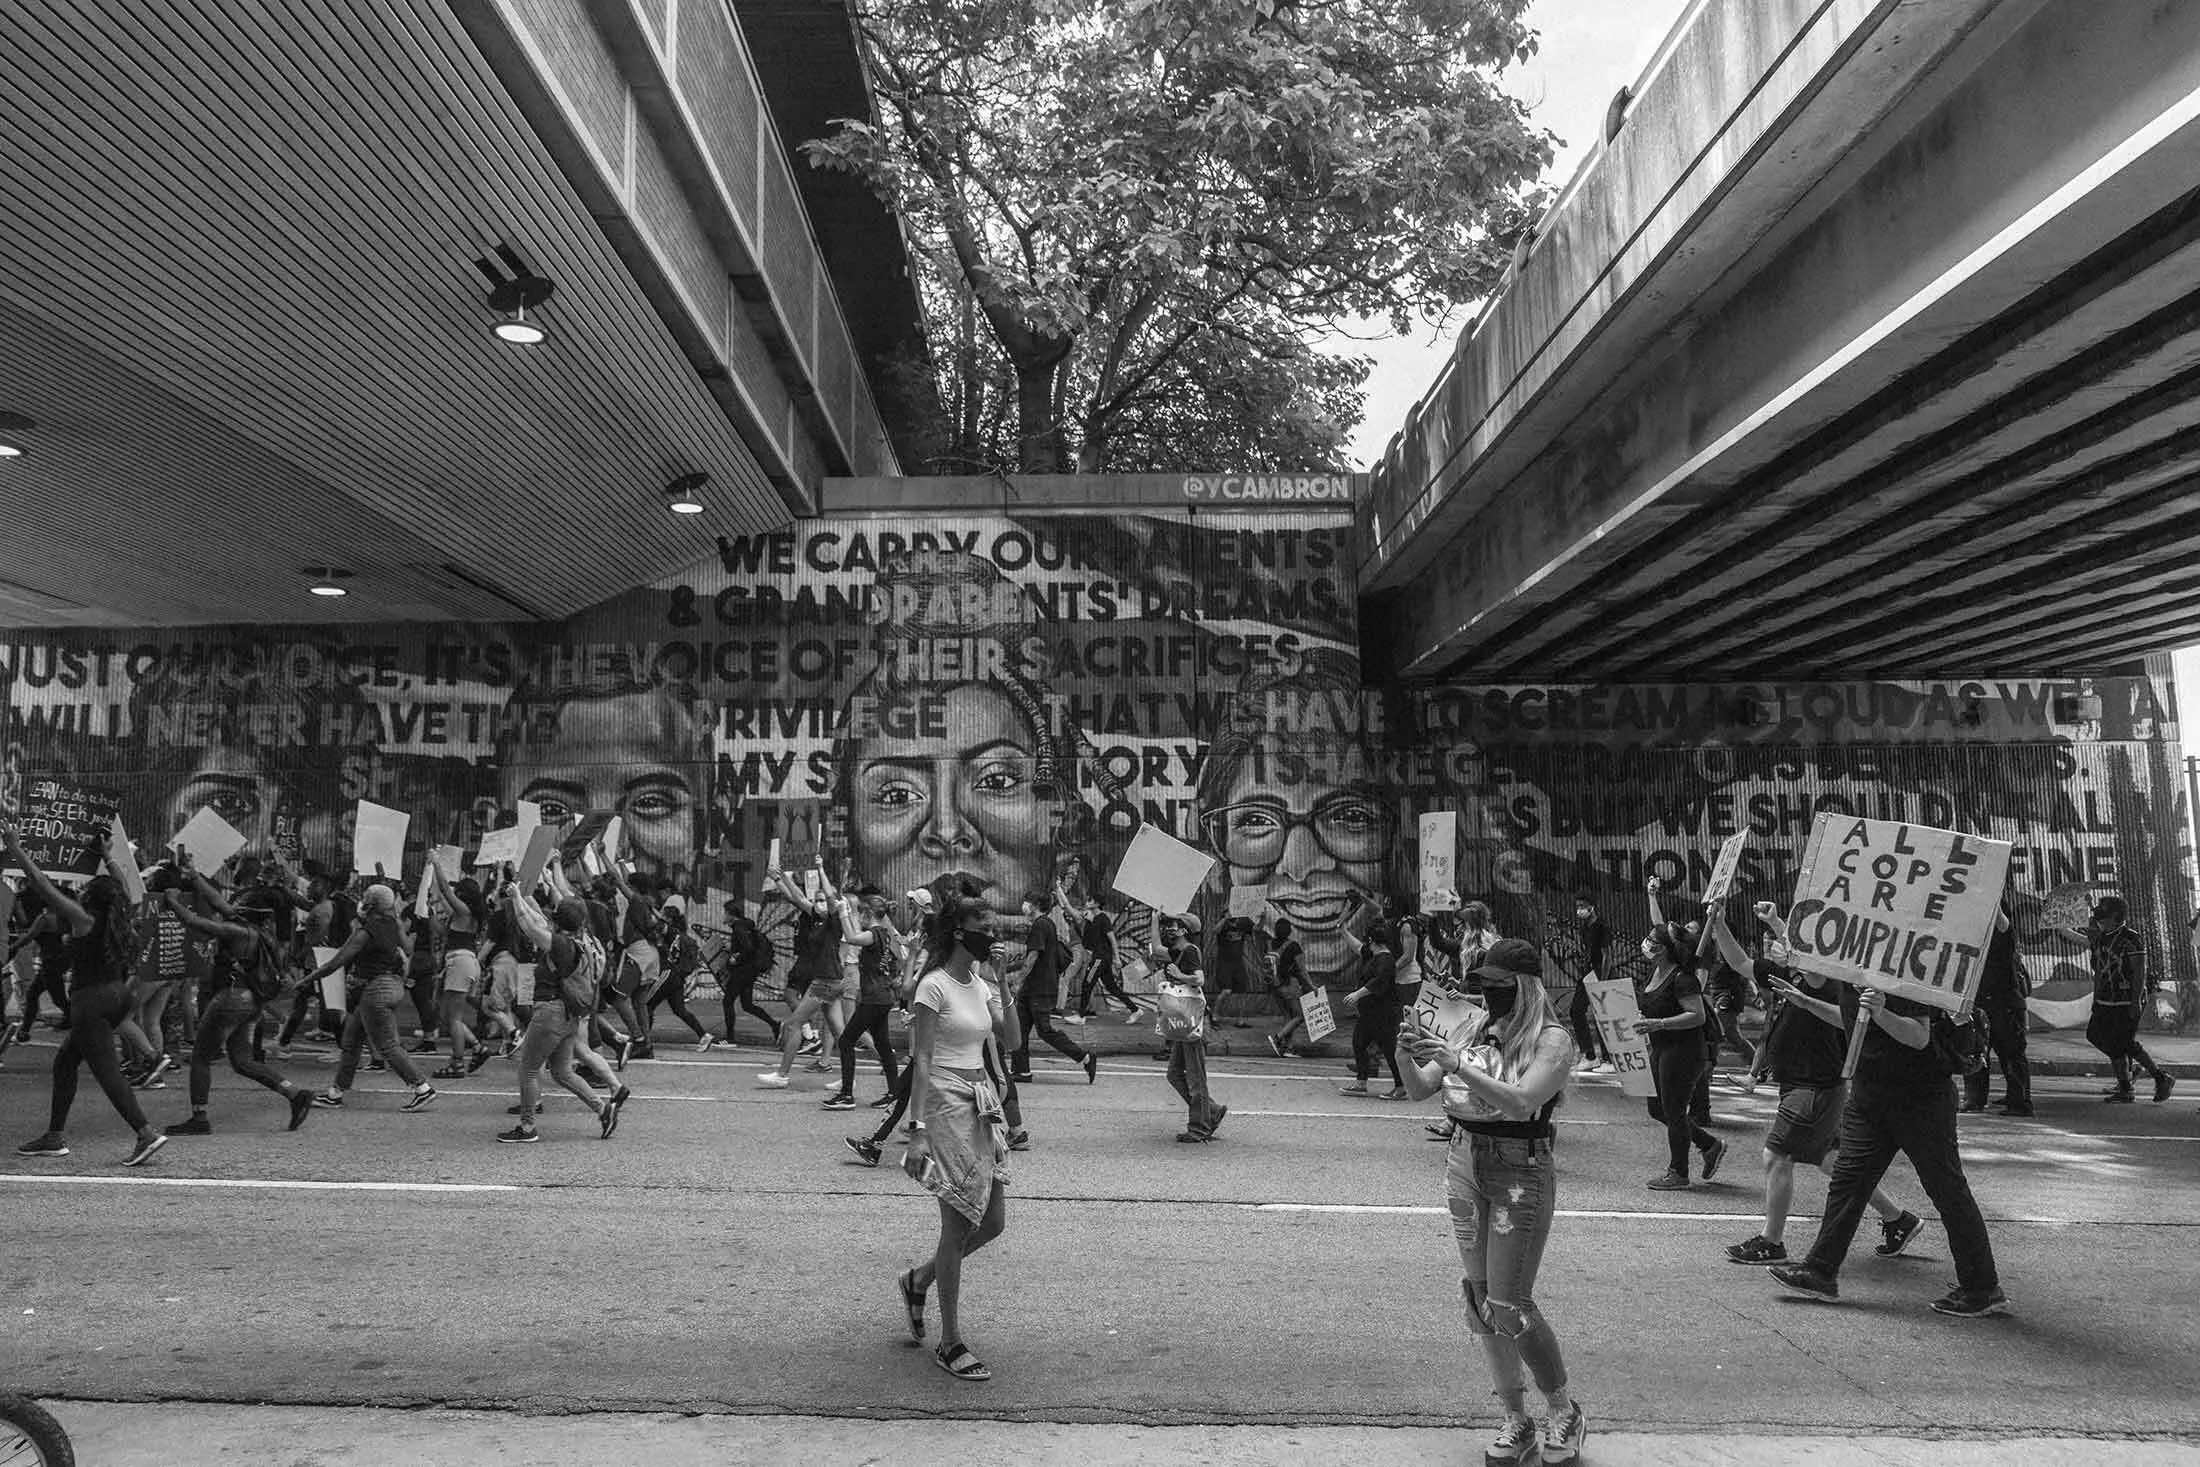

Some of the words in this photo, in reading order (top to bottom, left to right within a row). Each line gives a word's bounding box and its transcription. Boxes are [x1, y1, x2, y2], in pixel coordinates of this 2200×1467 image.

[1182, 476, 1348, 500] @YCAMBRON
[717, 534, 796, 574] WE
[806, 531, 980, 573] CARRY
[991, 530, 1097, 571] OUR
[425, 642, 511, 687] IT'S
[790, 638, 858, 681] OF
[318, 702, 449, 745] HAVE
[1043, 691, 1170, 737] THAT
[1264, 689, 1385, 734] HAVE
[717, 751, 797, 796] MY
[1651, 794, 1735, 837] WE
[58, 845, 85, 866] 1:17
[1843, 819, 1978, 866] ALL
[1838, 849, 1969, 894] COPS
[1825, 875, 1948, 920] ARE
[1788, 899, 1980, 993] COMPLICIT
